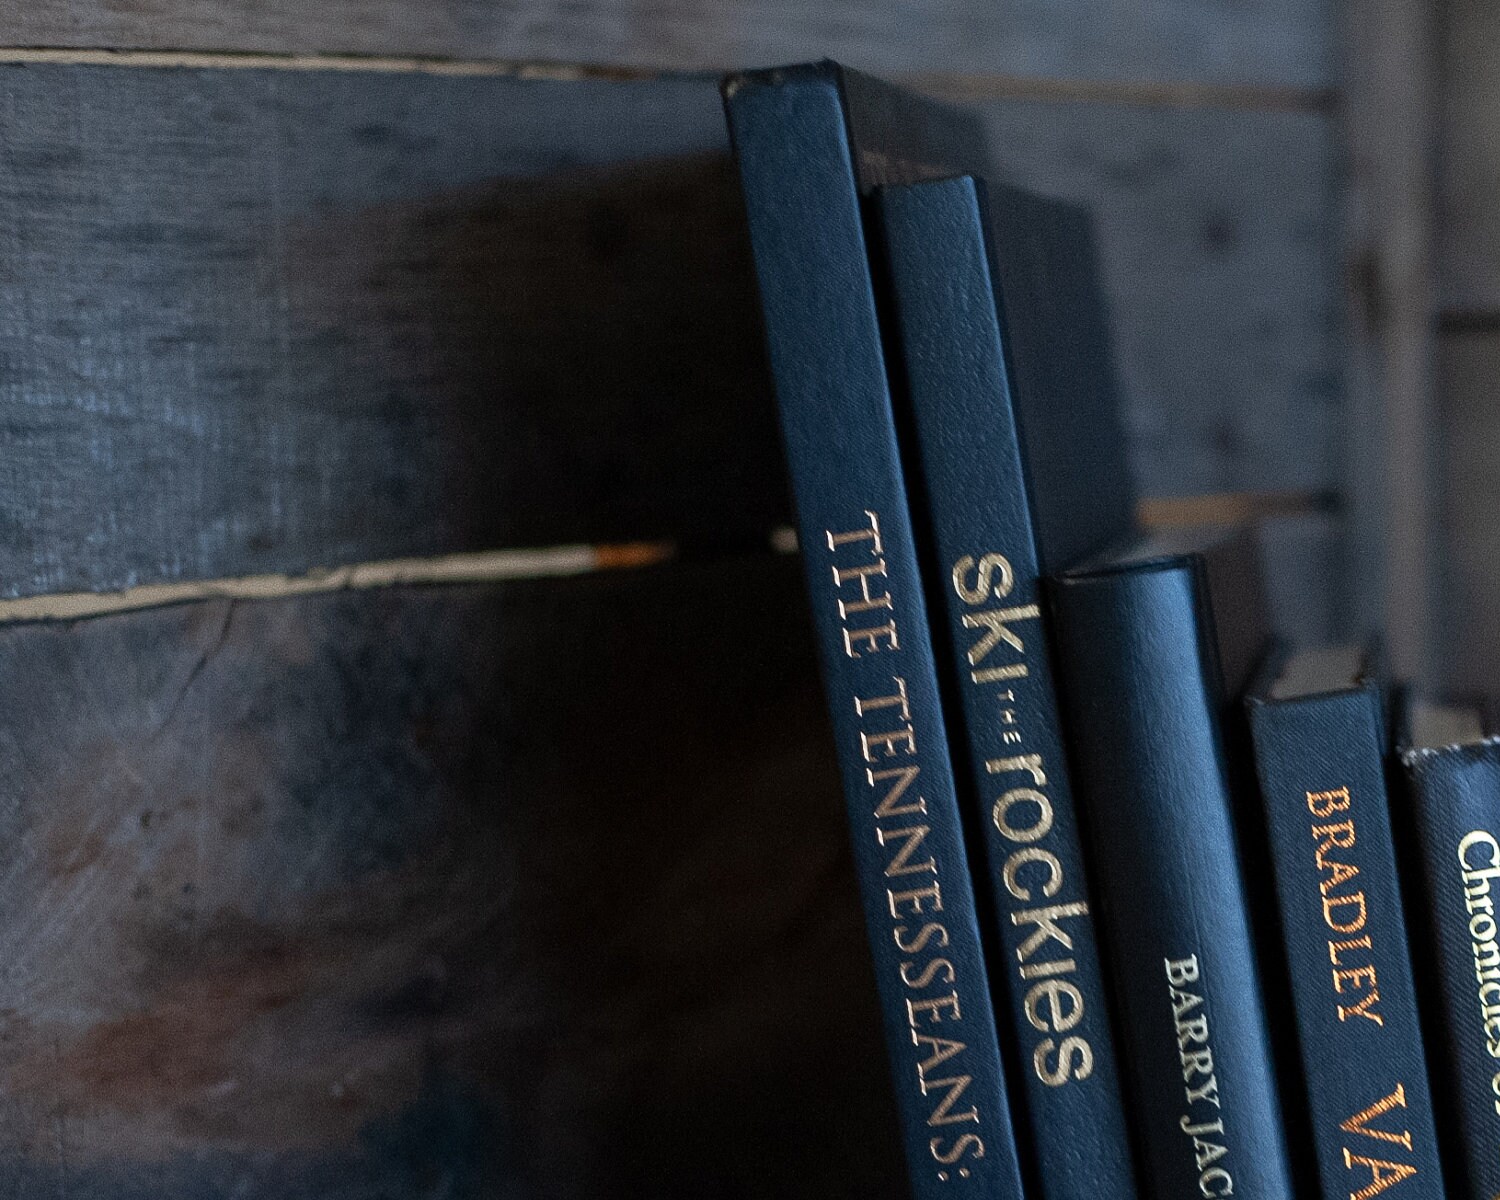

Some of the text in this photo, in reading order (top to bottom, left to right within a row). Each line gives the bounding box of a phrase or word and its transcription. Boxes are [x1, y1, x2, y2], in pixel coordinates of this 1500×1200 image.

[825, 508, 901, 660] THE
[853, 674, 987, 1183] TENNESSEANS:
[984, 752, 1095, 1089] rockies
[1305, 783, 1386, 1029] BRADLEY
[1163, 952, 1222, 1110] BARRY
